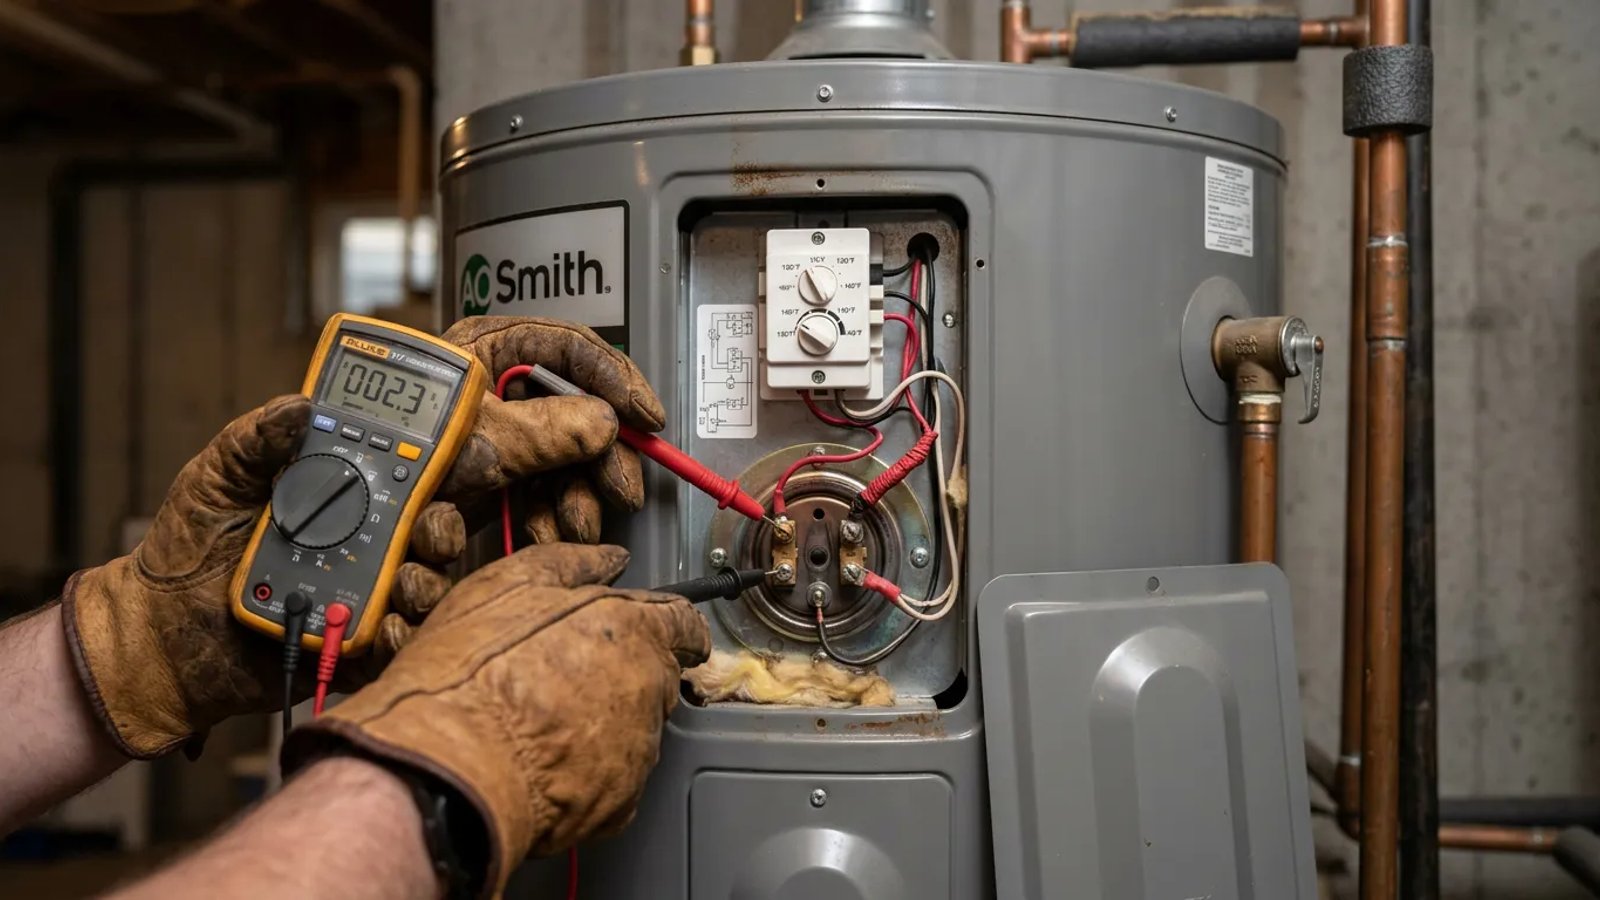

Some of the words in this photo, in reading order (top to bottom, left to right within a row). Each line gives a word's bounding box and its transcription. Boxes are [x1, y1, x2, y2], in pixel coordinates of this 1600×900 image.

[461, 264, 491, 308] AO
[496, 250, 603, 303] Smith
[343, 363, 427, 415] 002.3
